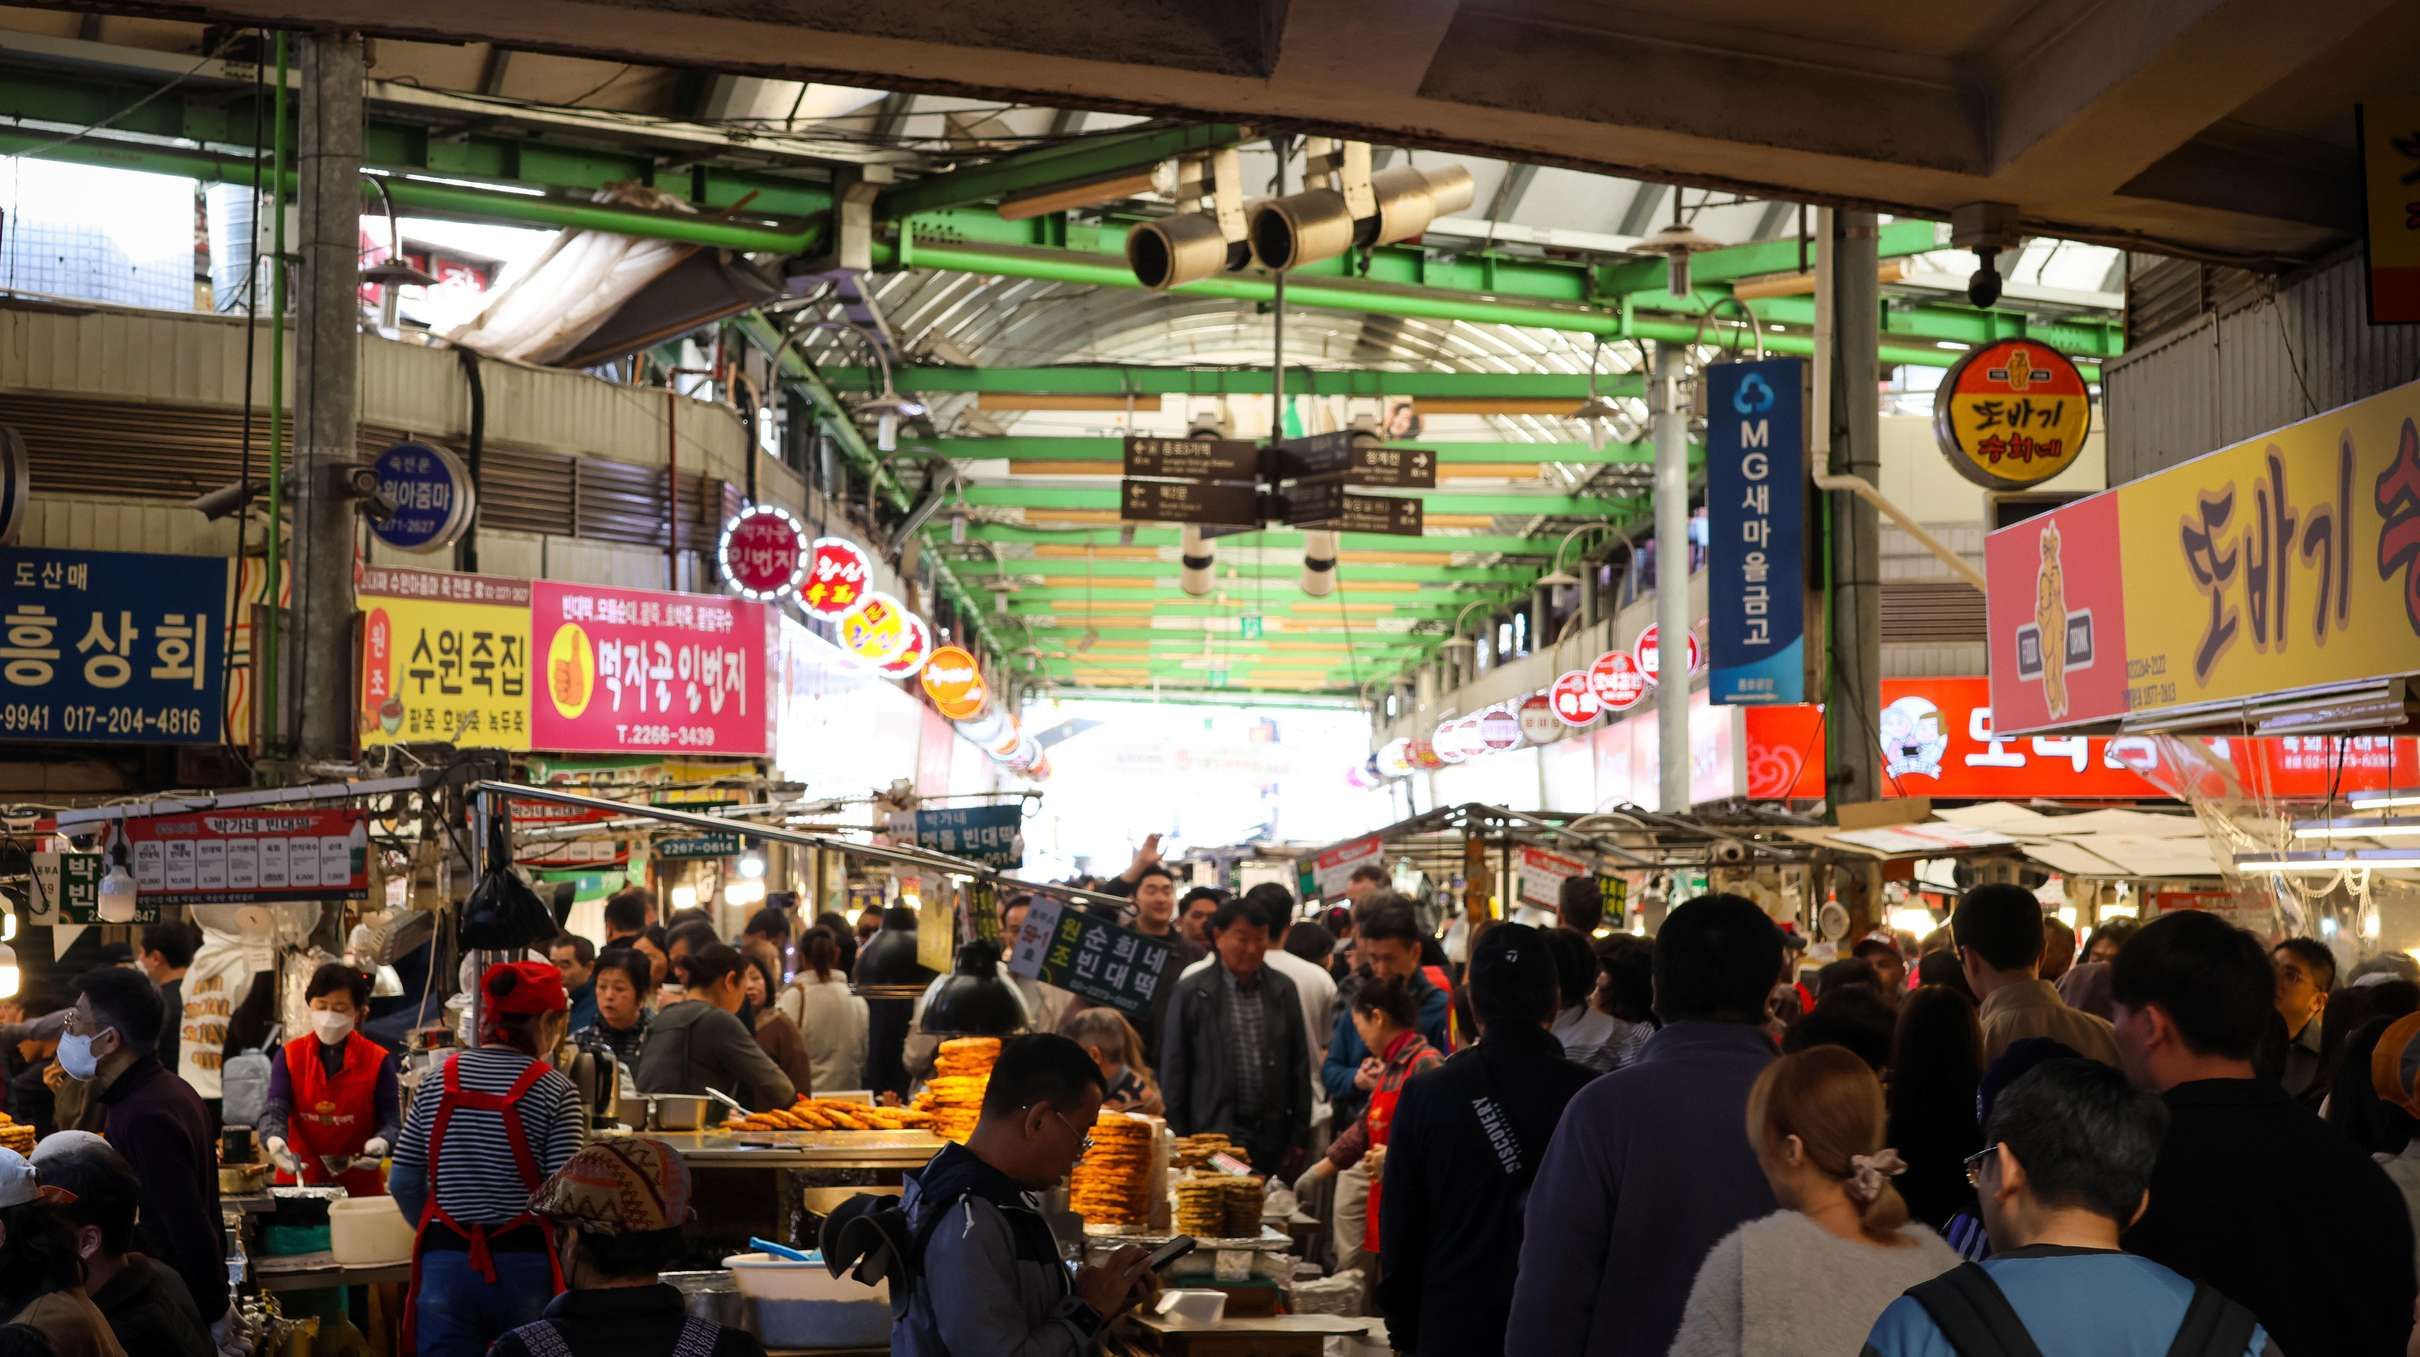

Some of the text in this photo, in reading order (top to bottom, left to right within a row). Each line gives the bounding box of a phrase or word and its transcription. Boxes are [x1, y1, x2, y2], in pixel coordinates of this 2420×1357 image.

[14, 561, 89, 592] 도산매
[728, 546, 796, 578] 일번지
[369, 621, 387, 698] 원조
[409, 627, 526, 698] 수원죽집
[63, 705, 201, 735] 017-204-4816
[1085, 924, 1169, 974] 순희네
[1075, 949, 1159, 1001] 빈대떡
[1471, 1096, 1518, 1175] DISCOVERY
